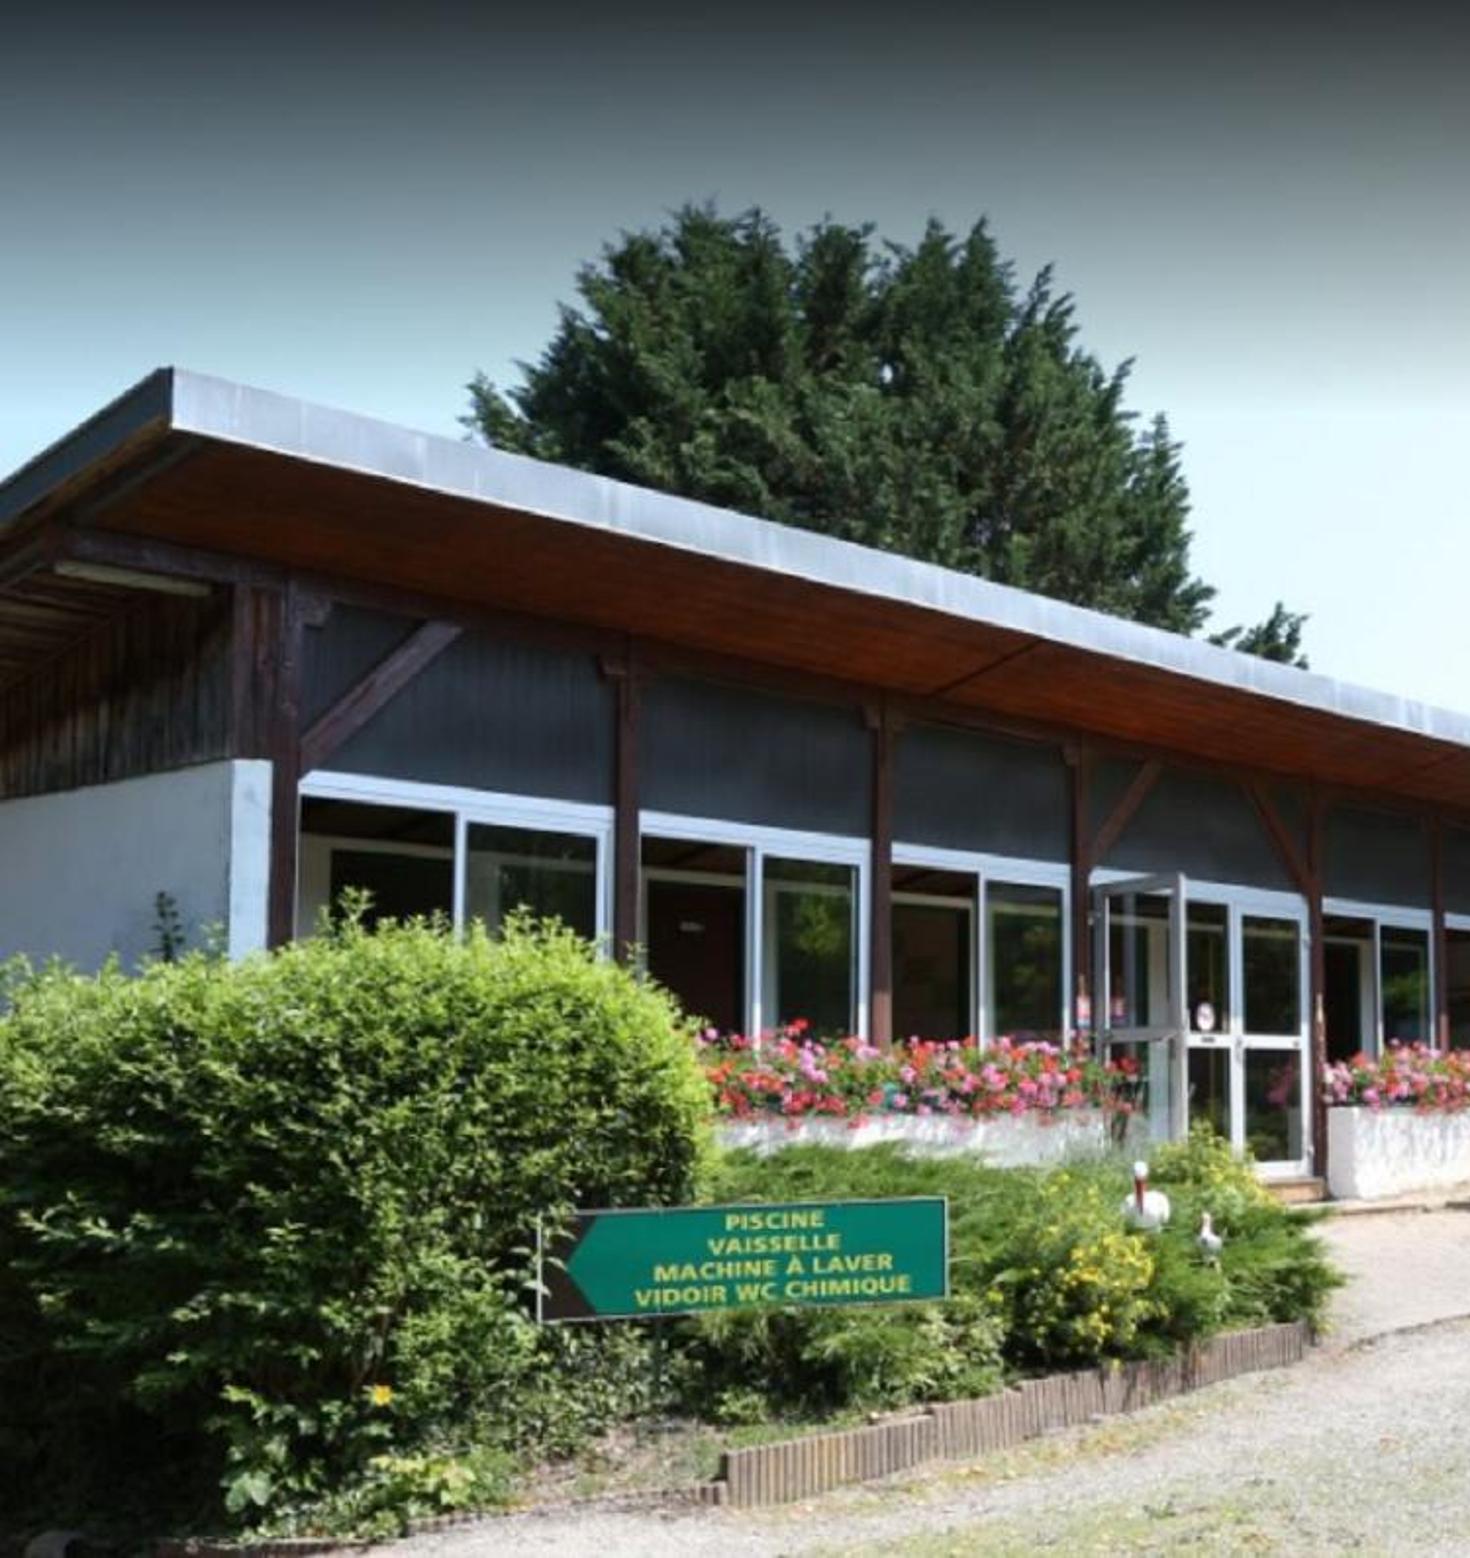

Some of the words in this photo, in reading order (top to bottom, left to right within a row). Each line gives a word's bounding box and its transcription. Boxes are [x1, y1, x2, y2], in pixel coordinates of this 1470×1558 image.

[725, 1211, 825, 1231] PISCINE
[707, 1234, 841, 1256] VAISSELLE
[653, 1259, 776, 1282] MACHINE
[786, 1253, 804, 1275] À
[812, 1253, 893, 1275] LAVER
[634, 1284, 727, 1308] VIDOIR
[735, 1282, 777, 1301] WC
[784, 1274, 911, 1298] CHIMIQUE
